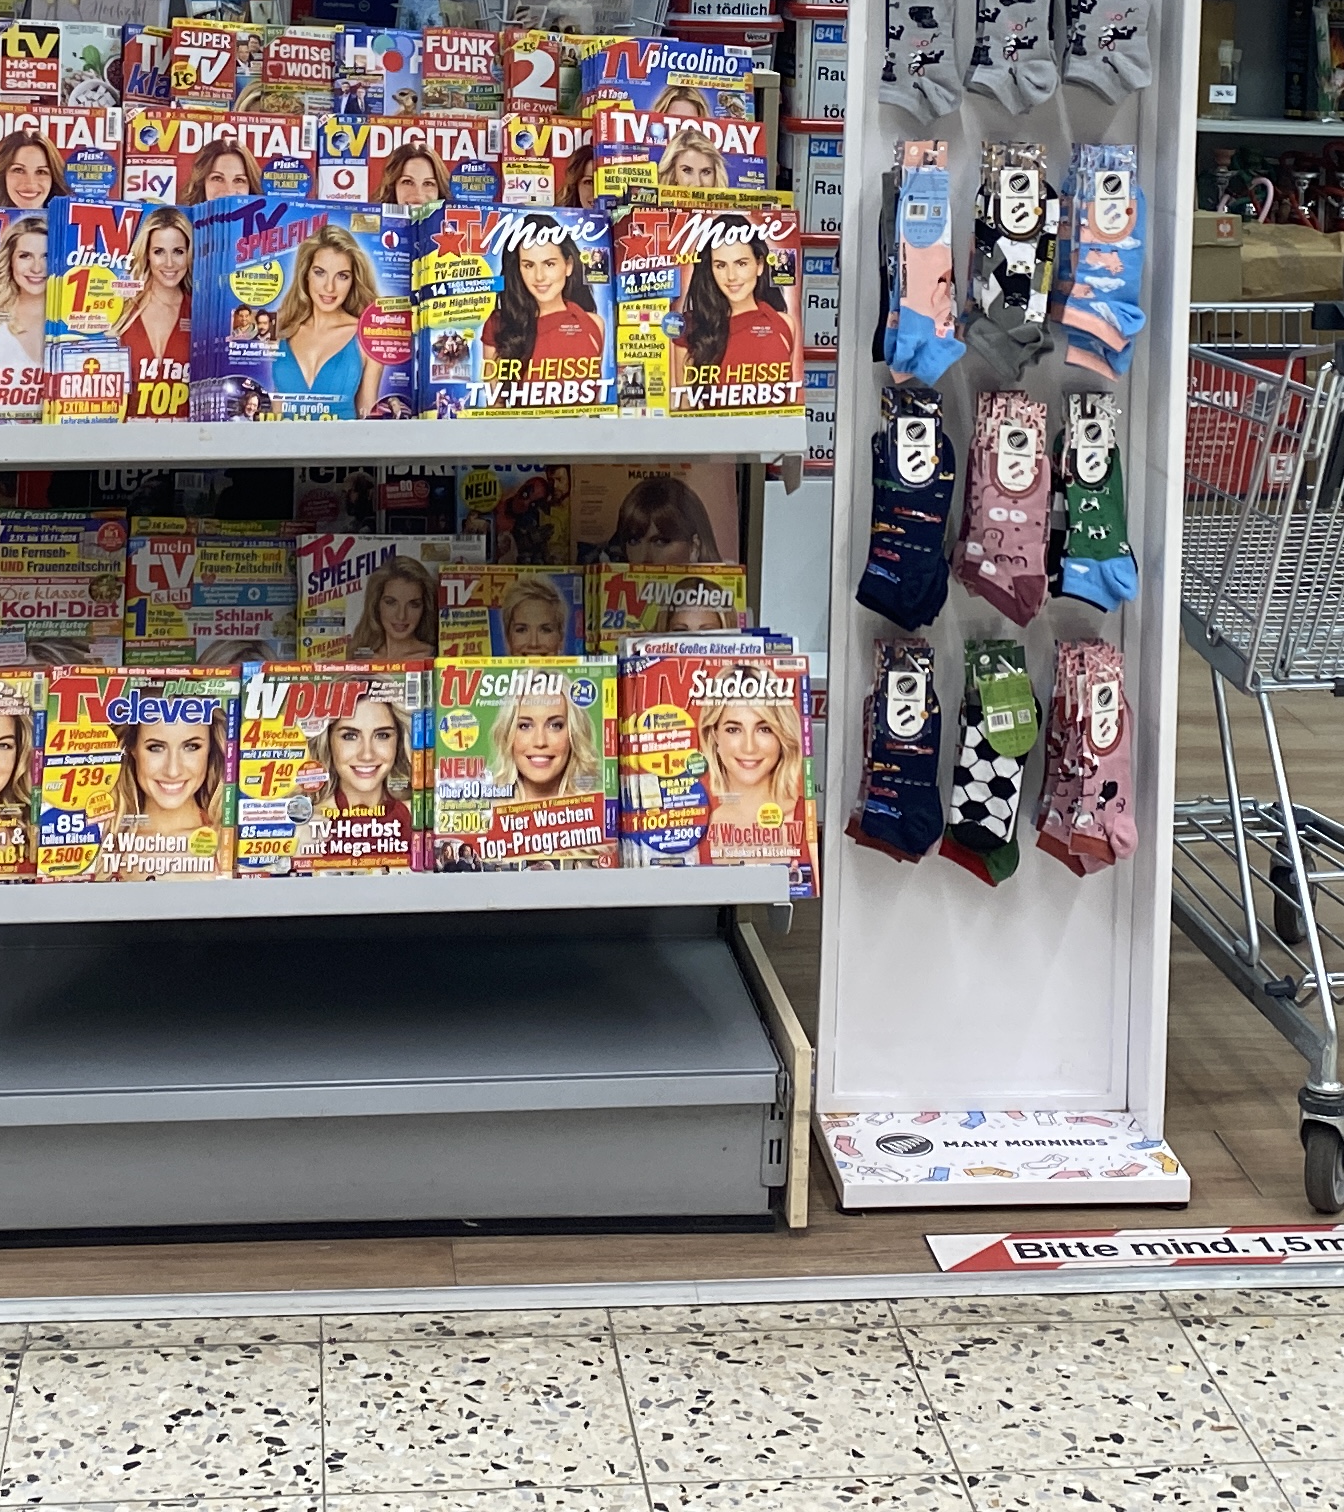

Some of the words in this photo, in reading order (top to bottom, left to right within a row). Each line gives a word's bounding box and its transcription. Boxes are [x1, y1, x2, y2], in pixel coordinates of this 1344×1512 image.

[0, 23, 59, 59] tv
[180, 30, 231, 49] SUPER
[425, 36, 495, 57] FUNK
[5, 59, 57, 71] Hören
[174, 47, 231, 85] TV
[434, 54, 489, 74] UHR
[603, 41, 662, 80] TV
[646, 45, 738, 76] piccolino
[5, 69, 36, 80] und
[5, 78, 57, 90] Sehen
[610, 111, 650, 144] TV
[126, 169, 174, 197] sky
[68, 202, 144, 254] TV
[236, 213, 329, 264] SPIELFILM
[480, 212, 609, 256] Movie
[668, 213, 797, 255] Movie
[66, 245, 135, 271] direkt
[620, 255, 675, 272] DIGITAL
[619, 274, 635, 287] 14
[639, 269, 675, 284] TAGE
[480, 358, 522, 381] DER
[527, 356, 602, 380] HEISSE
[683, 365, 721, 385] DER
[725, 361, 792, 384] HEISSE
[60, 374, 121, 398] GRATIS!
[137, 382, 190, 415] TOP
[465, 378, 616, 407] TV-HERBST
[670, 381, 803, 410] TV-HERBST
[27, 560, 122, 574] Frauenzeitschrift
[644, 642, 679, 654] Gratis!
[679, 642, 707, 655] Großes
[709, 643, 762, 655] Rätsel-Extra
[480, 669, 563, 698] schlau
[689, 670, 795, 700] Sudoku
[106, 690, 221, 725] clever
[283, 679, 369, 728] pur
[439, 757, 486, 779] NEU!
[308, 818, 402, 839] TV-Herbst
[499, 814, 530, 833] Vier
[533, 806, 594, 827] Wochen
[11, 828, 26, 844] &
[101, 834, 115, 852] 4
[117, 832, 187, 853] Wochen
[301, 841, 327, 854] mit
[329, 839, 409, 857] Mega-Hits
[476, 825, 602, 859] Top-Programm
[102, 853, 215, 874] TV-Programm
[943, 1136, 998, 1151] MANY
[1003, 1134, 1108, 1151] MORNINGS
[1013, 1235, 1122, 1261] Bitte
